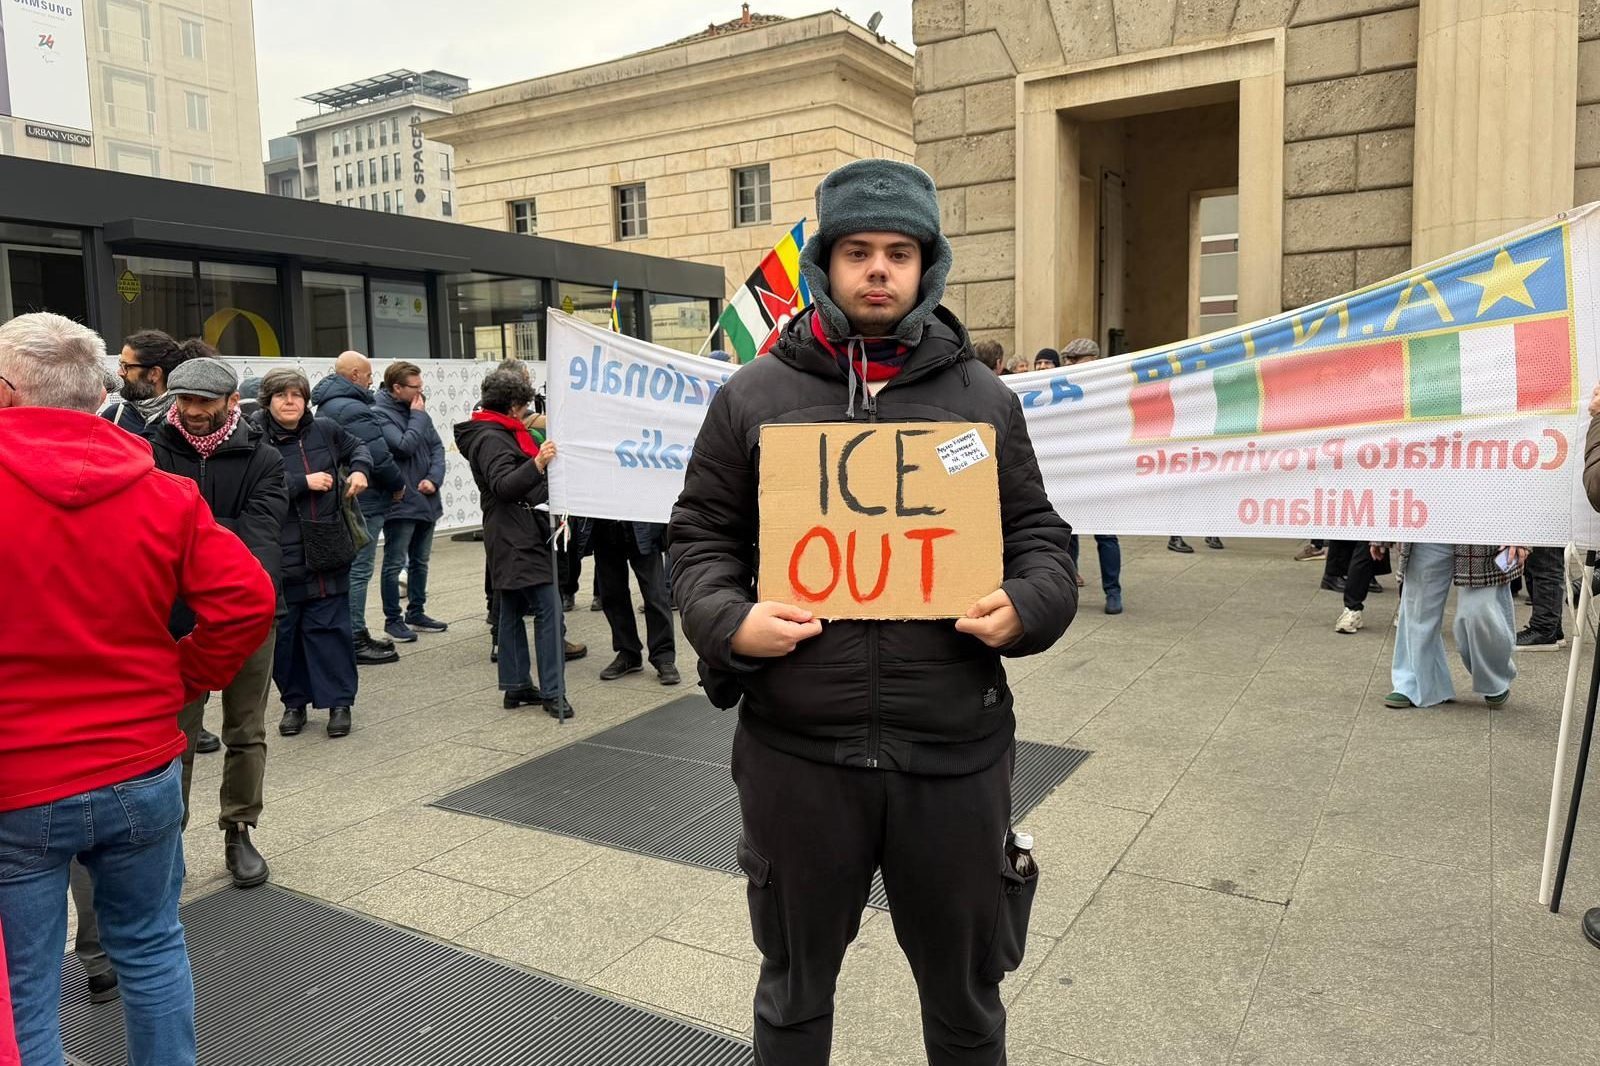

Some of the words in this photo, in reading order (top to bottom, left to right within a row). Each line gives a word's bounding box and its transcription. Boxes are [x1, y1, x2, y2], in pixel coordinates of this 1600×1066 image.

[13, 0, 73, 17] AMSUNG
[28, 126, 59, 139] URBAN
[60, 132, 90, 145] VISION
[819, 429, 946, 517] ICE
[788, 525, 957, 604] OUT
